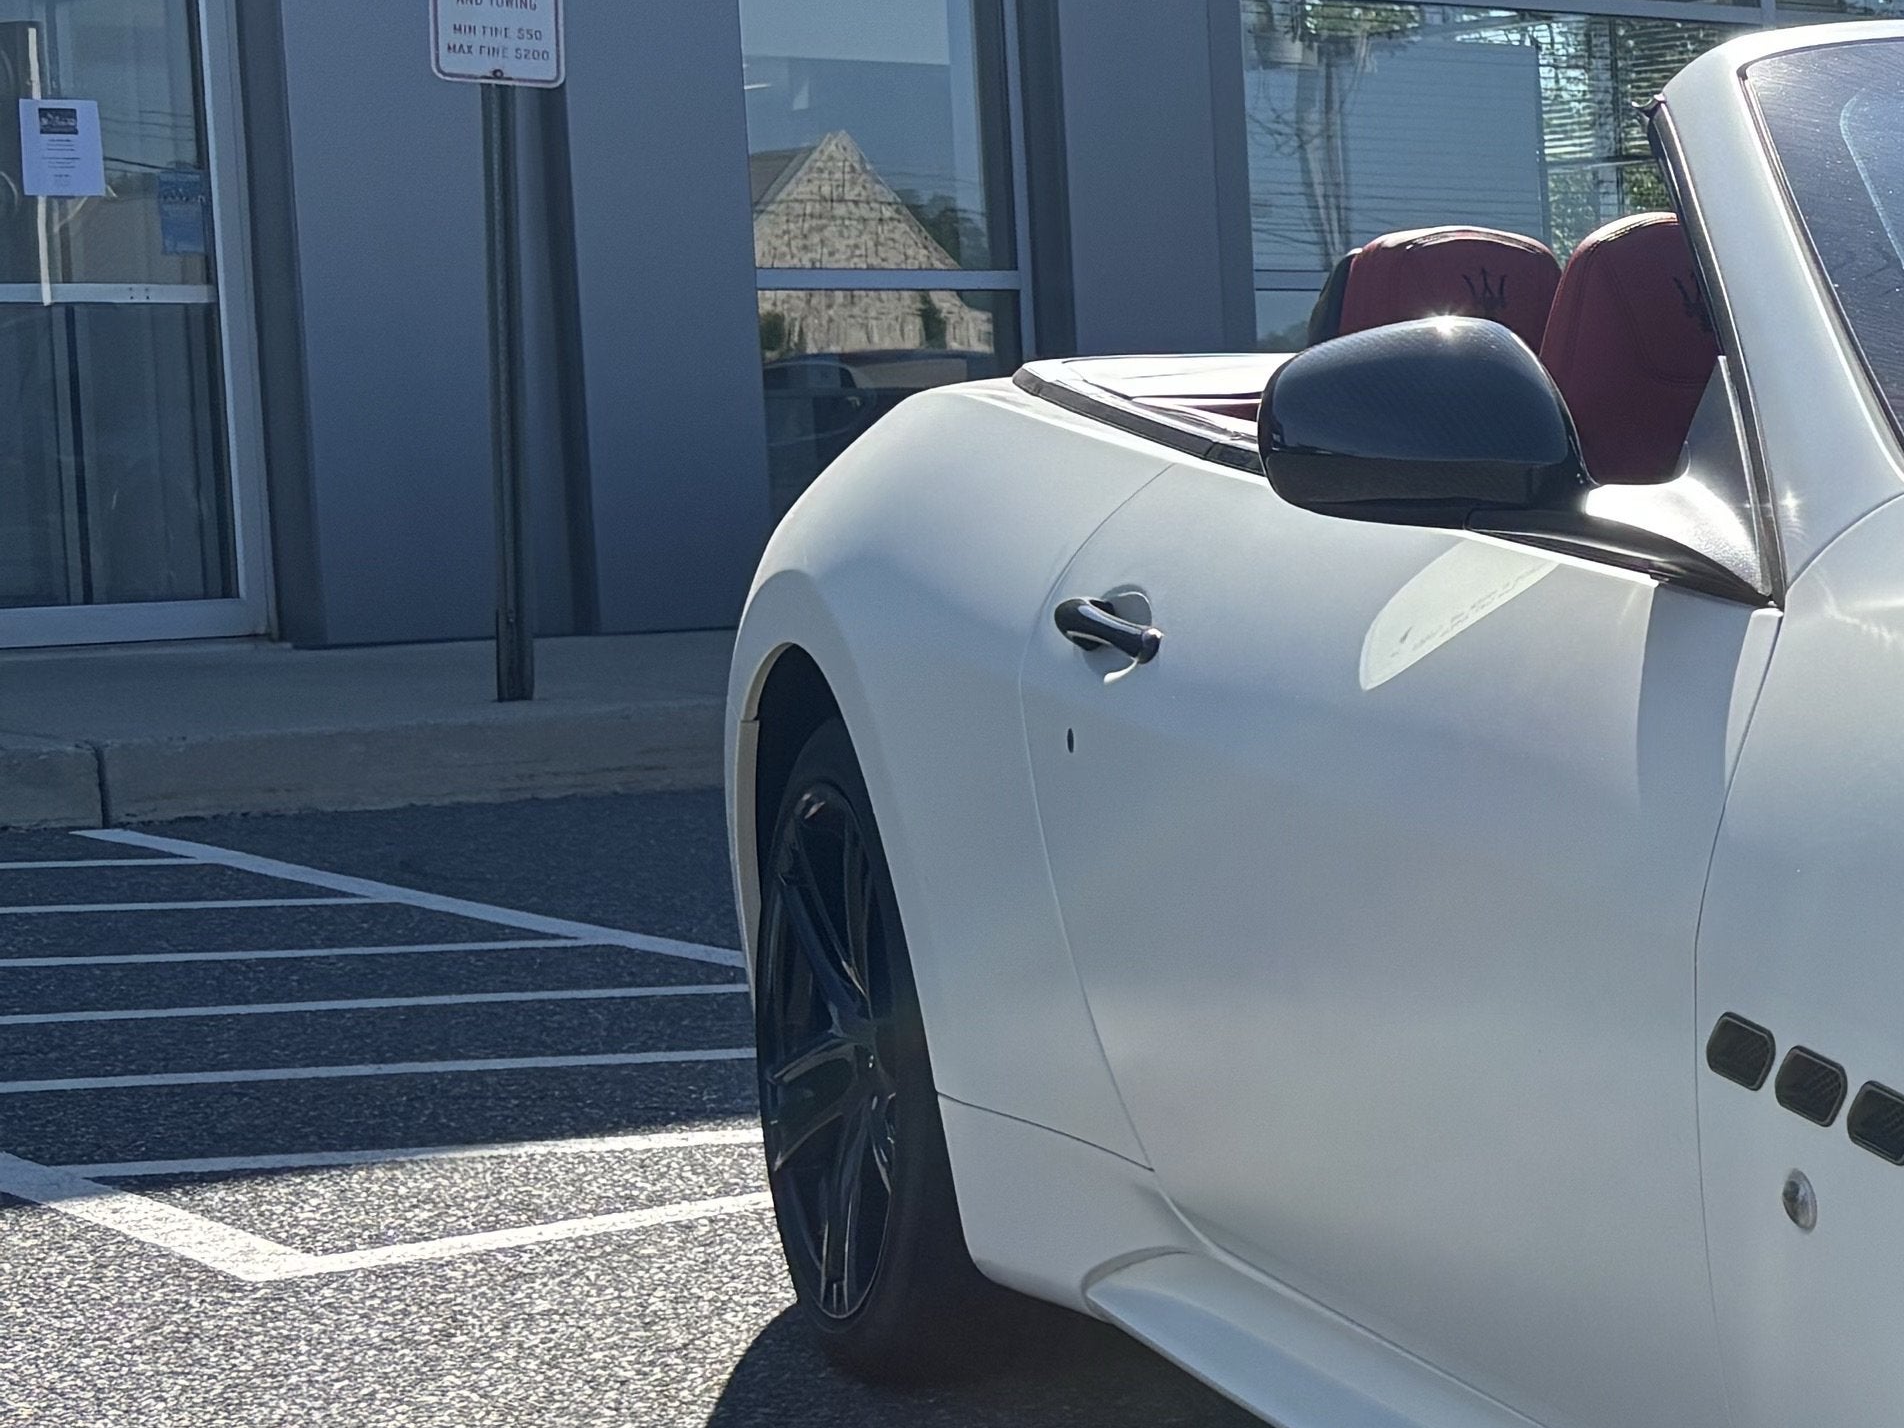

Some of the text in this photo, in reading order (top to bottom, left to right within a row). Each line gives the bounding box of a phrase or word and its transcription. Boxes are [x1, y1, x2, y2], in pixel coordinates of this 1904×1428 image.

[453, 24, 542, 40] MIN FINE $50
[447, 43, 550, 60] MAX FINE $200
